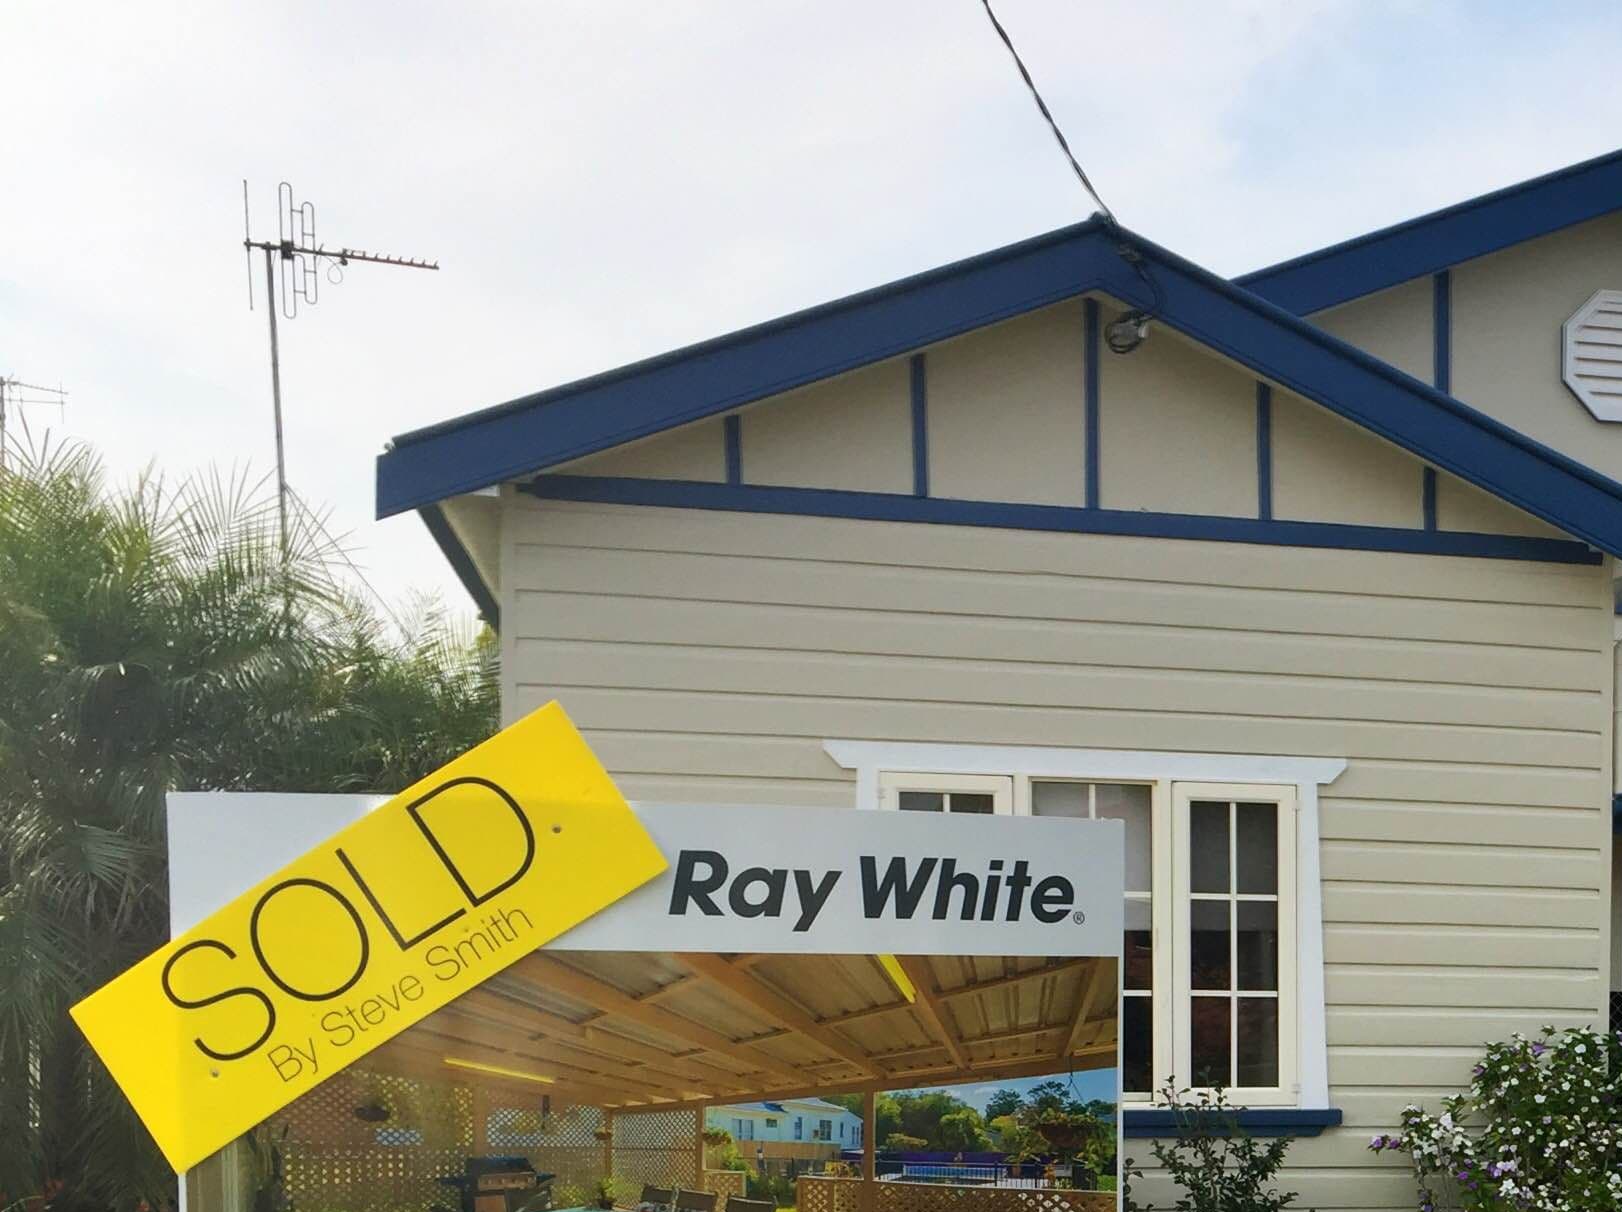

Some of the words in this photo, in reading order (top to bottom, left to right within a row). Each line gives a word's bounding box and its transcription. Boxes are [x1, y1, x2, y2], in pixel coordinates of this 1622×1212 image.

[162, 776, 535, 1061] SOLD
[668, 849, 842, 932] Ray
[267, 1037, 318, 1082] By
[320, 974, 424, 1048] Steve
[425, 908, 533, 981] Smith
